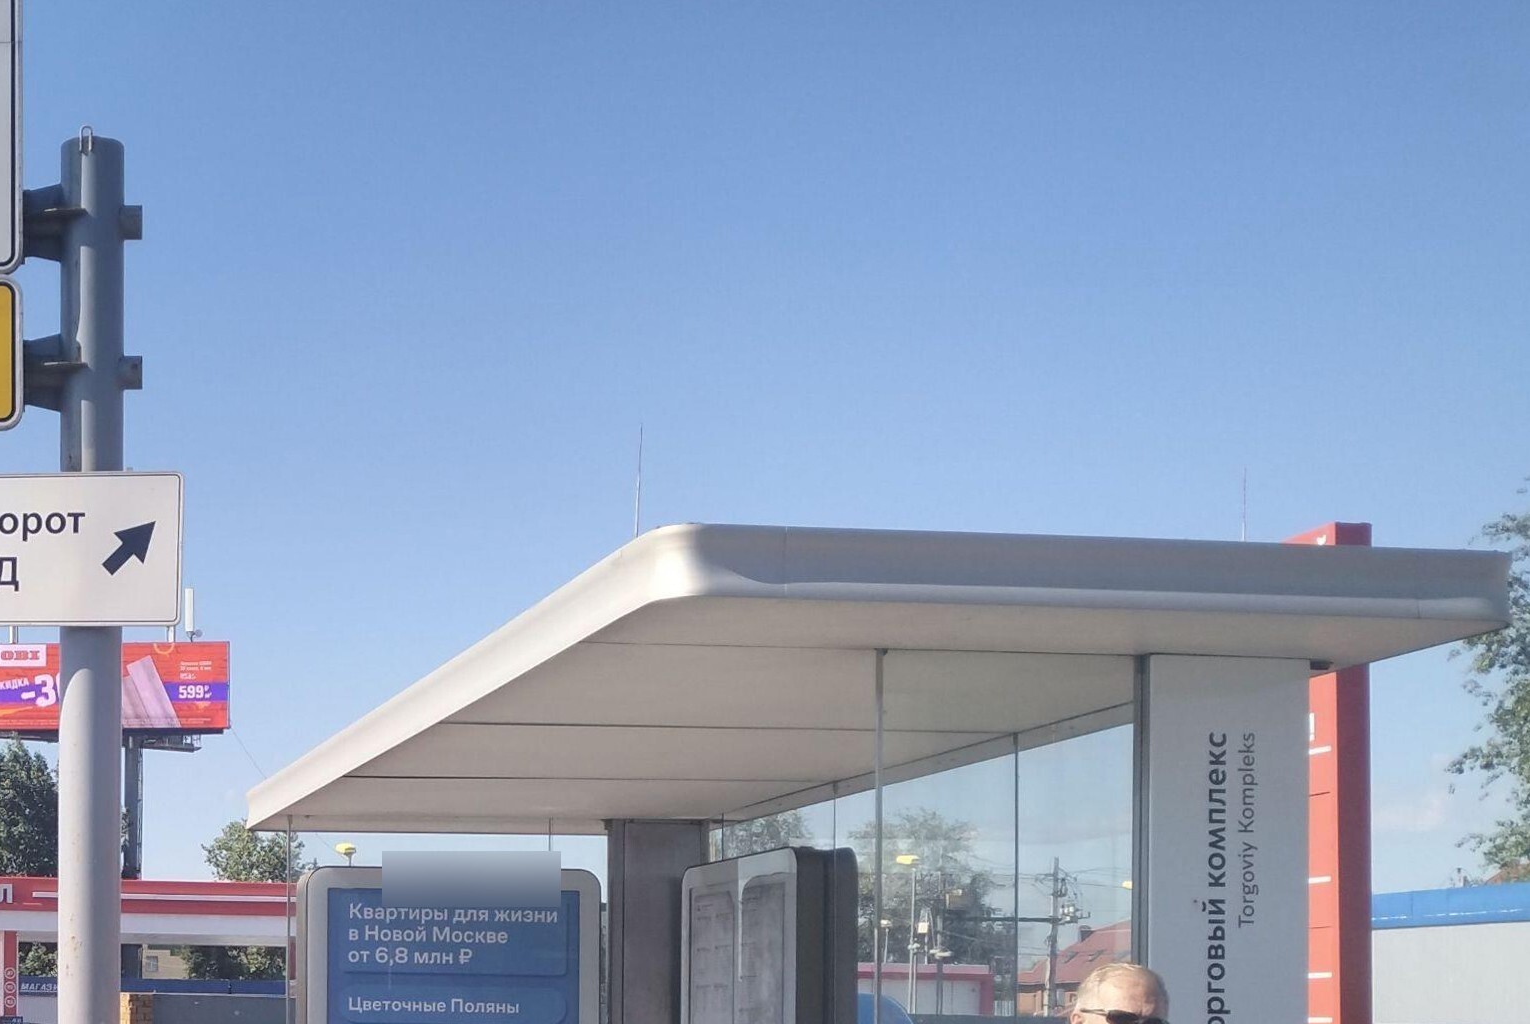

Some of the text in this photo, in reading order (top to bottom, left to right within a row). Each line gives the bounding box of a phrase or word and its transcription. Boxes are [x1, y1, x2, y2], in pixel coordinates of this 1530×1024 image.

[0, 650, 40, 660] OBI
[1208, 733, 1226, 887] комплекс
[1238, 733, 1258, 928] Torgoviy Kompleks
[349, 903, 557, 923] Квартиры для жизни
[349, 925, 507, 943] в Новой Москве
[348, 951, 370, 962] от
[376, 947, 408, 966] 6,8
[415, 952, 452, 964] млн
[349, 997, 519, 1013] Цветочные Поляны
